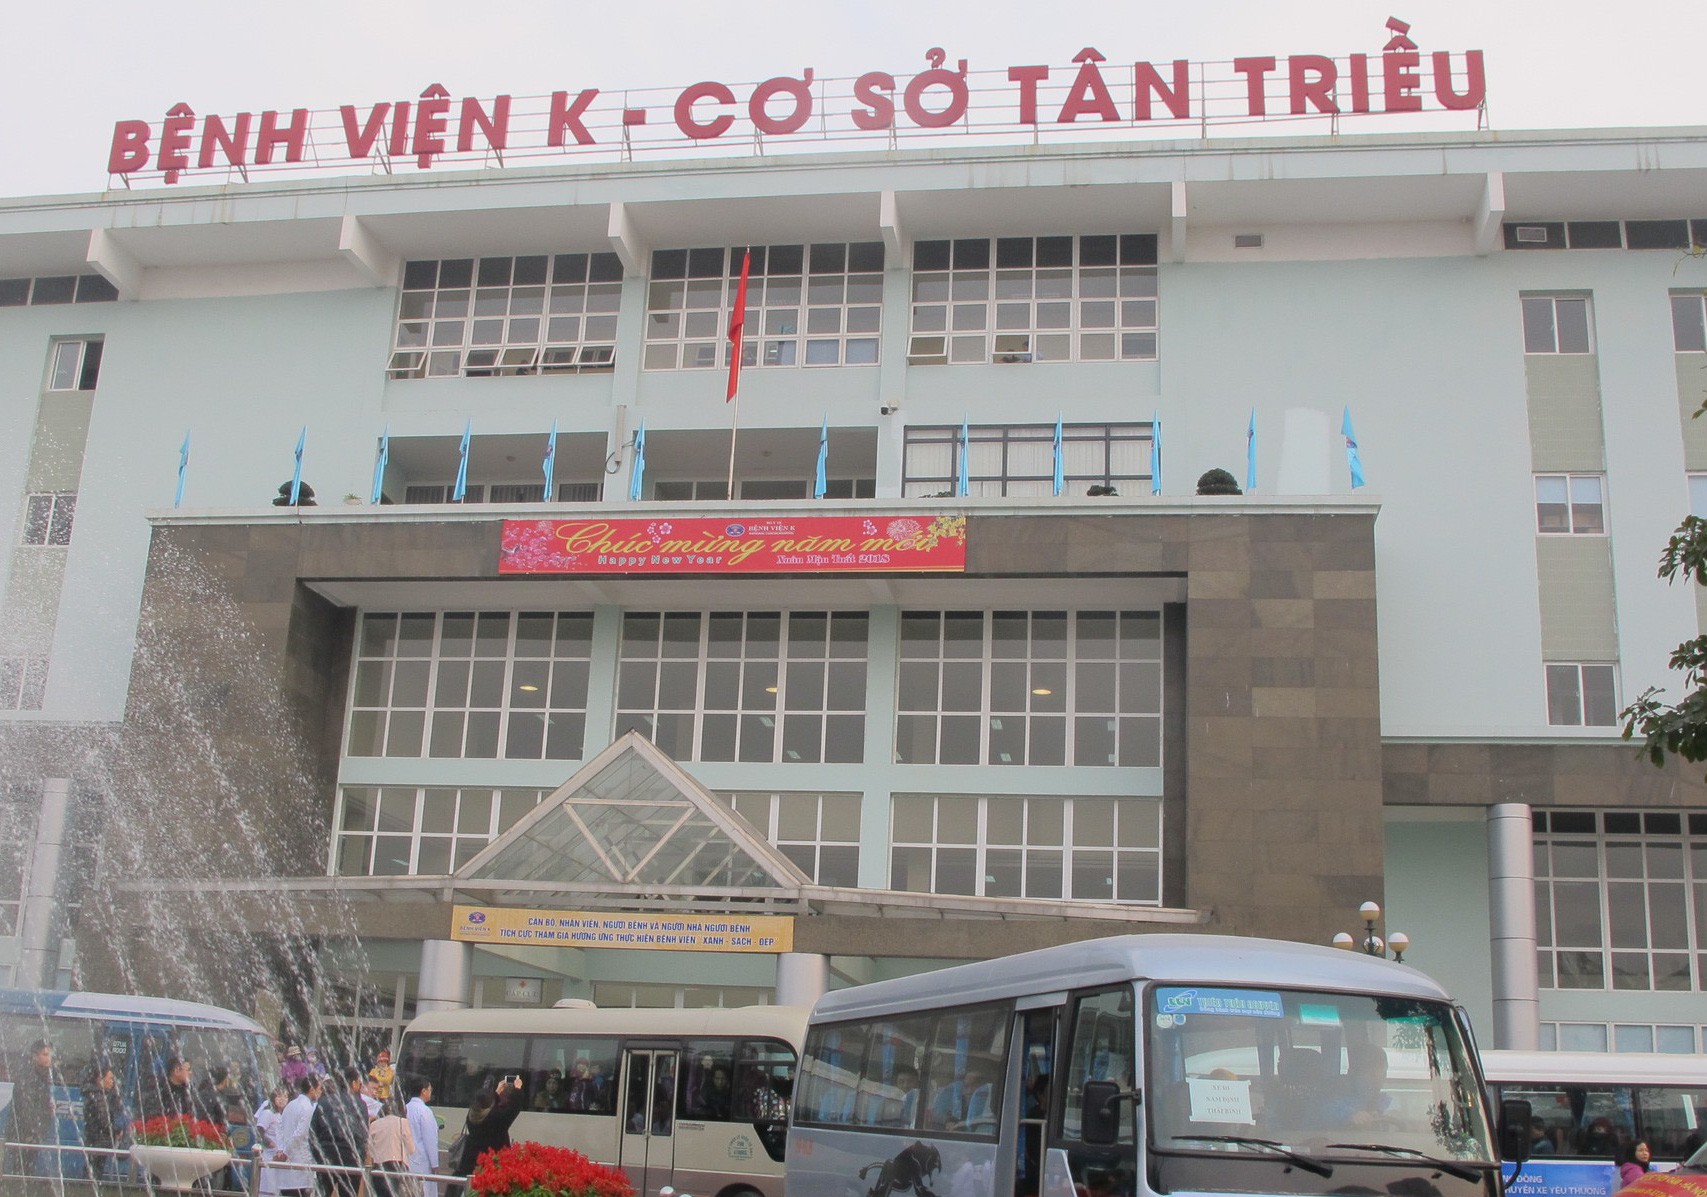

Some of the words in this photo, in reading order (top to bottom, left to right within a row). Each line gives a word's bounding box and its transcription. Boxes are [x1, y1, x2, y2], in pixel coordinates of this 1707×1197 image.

[108, 102, 308, 185] BỆNH
[340, 83, 511, 169] VIỆN
[548, 88, 599, 146] K
[674, 67, 812, 139] CƠ
[852, 47, 969, 131] SỞ
[1008, 47, 1189, 124] TÂN
[1234, 16, 1486, 117] TRIỀU
[556, 522, 653, 554] Chúc
[659, 531, 766, 566] mừng
[771, 535, 856, 553] năm
[860, 530, 935, 553] mới
[598, 555, 646, 567] Happy
[651, 555, 681, 565] New
[687, 554, 722, 565] Year
[776, 554, 803, 564] Xuân
[806, 554, 829, 565] Mậu
[832, 553, 856, 564] Tuất
[858, 554, 890, 564] 2018
[535, 930, 555, 939] THAM
[557, 931, 569, 940] GIA
